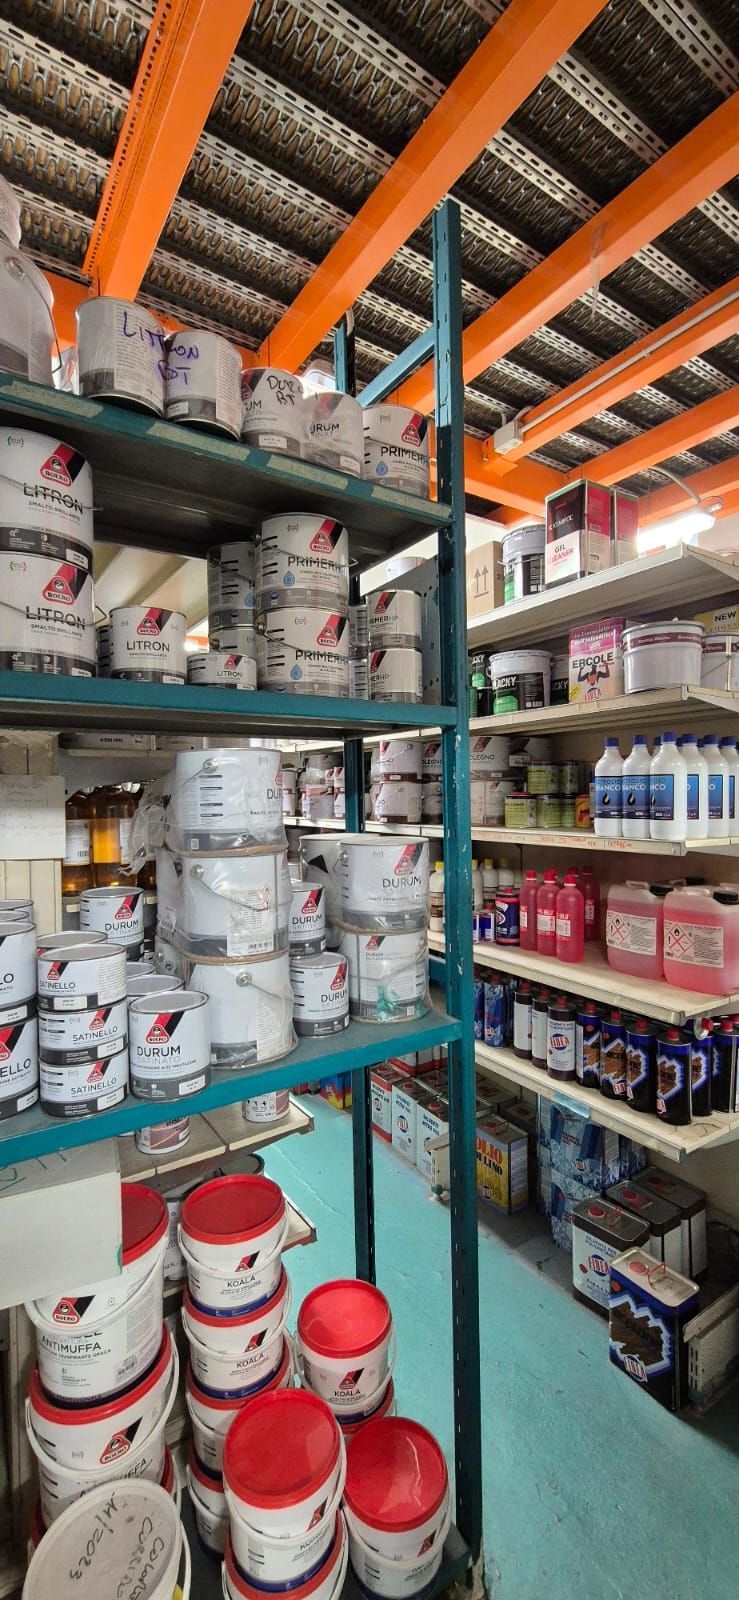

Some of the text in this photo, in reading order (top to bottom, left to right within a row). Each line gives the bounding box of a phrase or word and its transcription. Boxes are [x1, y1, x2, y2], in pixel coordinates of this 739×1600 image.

[45, 469, 69, 484] BOERO
[23, 482, 84, 514] LITRON
[554, 543, 566, 553] GEL
[47, 592, 71, 602] BOERO
[26, 605, 86, 630] LITRON
[714, 611, 737, 622] NEW
[126, 641, 170, 652] LITRON
[572, 652, 614, 669] ERCOLE
[216, 670, 243, 678] LITRON
[382, 876, 422, 888] DURUM
[104, 919, 139, 931] DURUM
[292, 914, 322, 925] DURUM
[72, 1025, 118, 1042] SATINELLO
[137, 1046, 181, 1057] DURUM
[0, 1058, 32, 1077] ELLO
[70, 1077, 117, 1094] SATINELLO
[483, 1156, 503, 1175] LINO
[227, 1276, 256, 1288] KOALA
[55, 1314, 76, 1322] BOERO
[41, 1335, 102, 1353] ANTIMUFFA
[236, 1353, 265, 1368] KOALA
[334, 1388, 361, 1398] KOALA
[104, 1446, 127, 1462] BOERO
